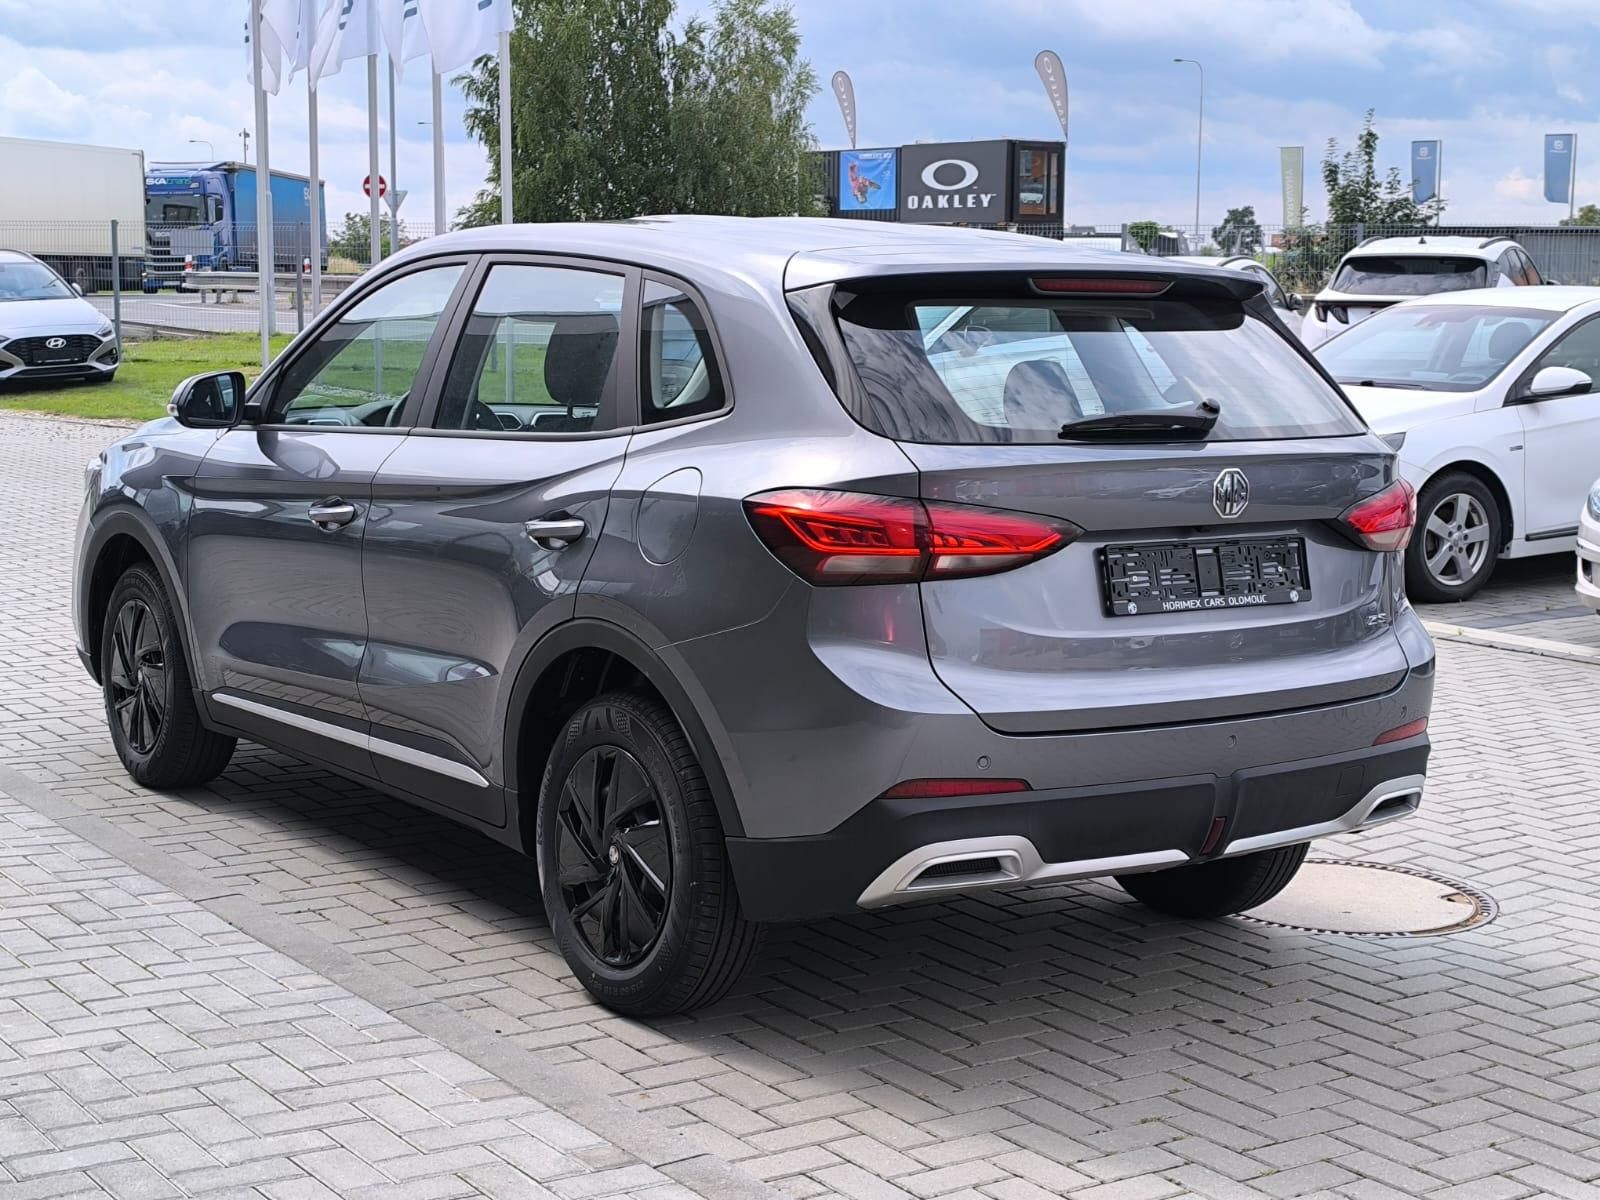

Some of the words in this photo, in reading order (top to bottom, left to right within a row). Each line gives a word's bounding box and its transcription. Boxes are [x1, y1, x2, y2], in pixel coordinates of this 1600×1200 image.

[907, 194, 993, 210] OAKLEY
[1214, 469, 1249, 517] MG
[1162, 600, 1201, 611] HORIMEX
[1204, 597, 1226, 608] CARS
[1228, 594, 1268, 606] OLOMOUC
